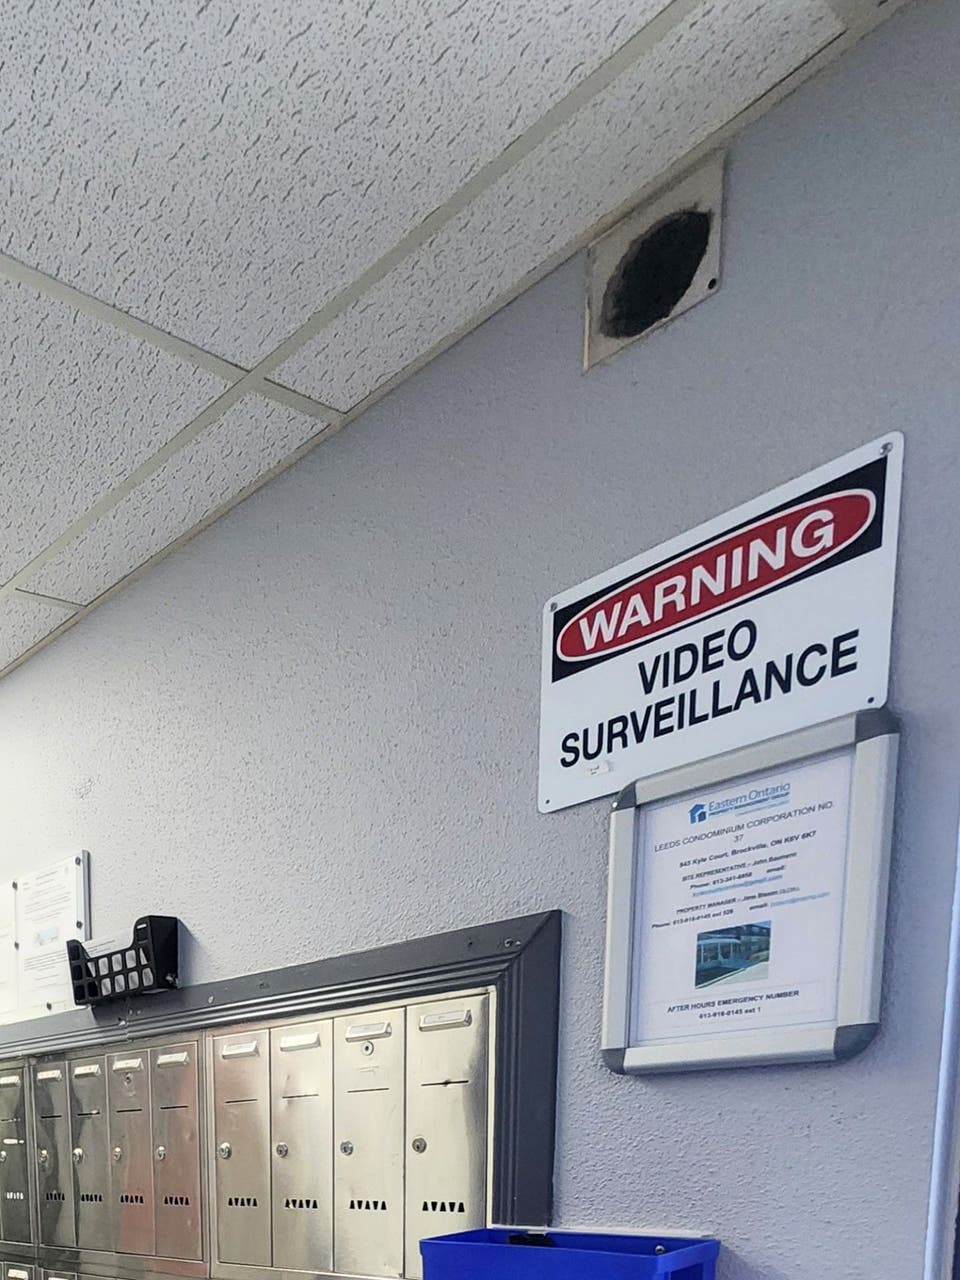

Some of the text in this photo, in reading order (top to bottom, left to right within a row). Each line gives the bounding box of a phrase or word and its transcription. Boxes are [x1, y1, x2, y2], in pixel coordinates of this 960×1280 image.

[578, 509, 836, 652] WARNING
[638, 619, 758, 695] VIDEO
[560, 629, 859, 768] SURVEILLANCE
[708, 795, 747, 812] Eastern
[748, 783, 791, 800] Ontario
[654, 840, 681, 852] LEEDS
[682, 824, 745, 846] CONDOMINIUM
[746, 805, 816, 829] CORPORATION
[733, 834, 744, 844] 37
[692, 856, 708, 867] Kyle
[770, 838, 783, 846] ON
[695, 863, 748, 880] REPRESENTATIVE
[676, 904, 707, 915] PROPERTY
[707, 898, 737, 909] MANAGER
[667, 990, 800, 1013] AFTER HOURS EMERGENCY NUMBER
